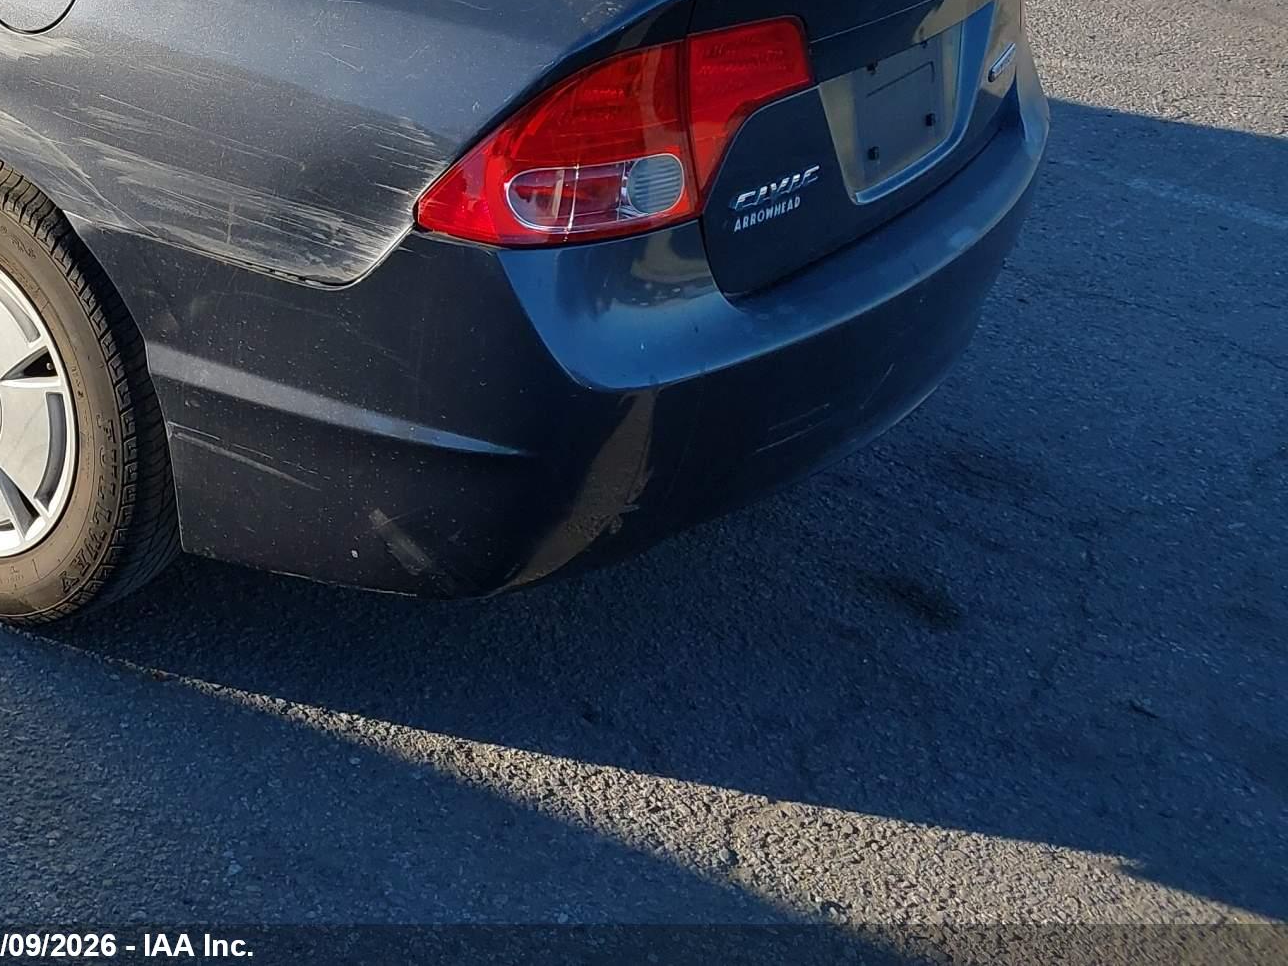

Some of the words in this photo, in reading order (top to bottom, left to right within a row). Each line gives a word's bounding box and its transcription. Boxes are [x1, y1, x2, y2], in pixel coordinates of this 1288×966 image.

[732, 165, 820, 210] CIVIC
[733, 195, 801, 232] ARROWHEAD
[60, 413, 119, 593] FULLWAY
